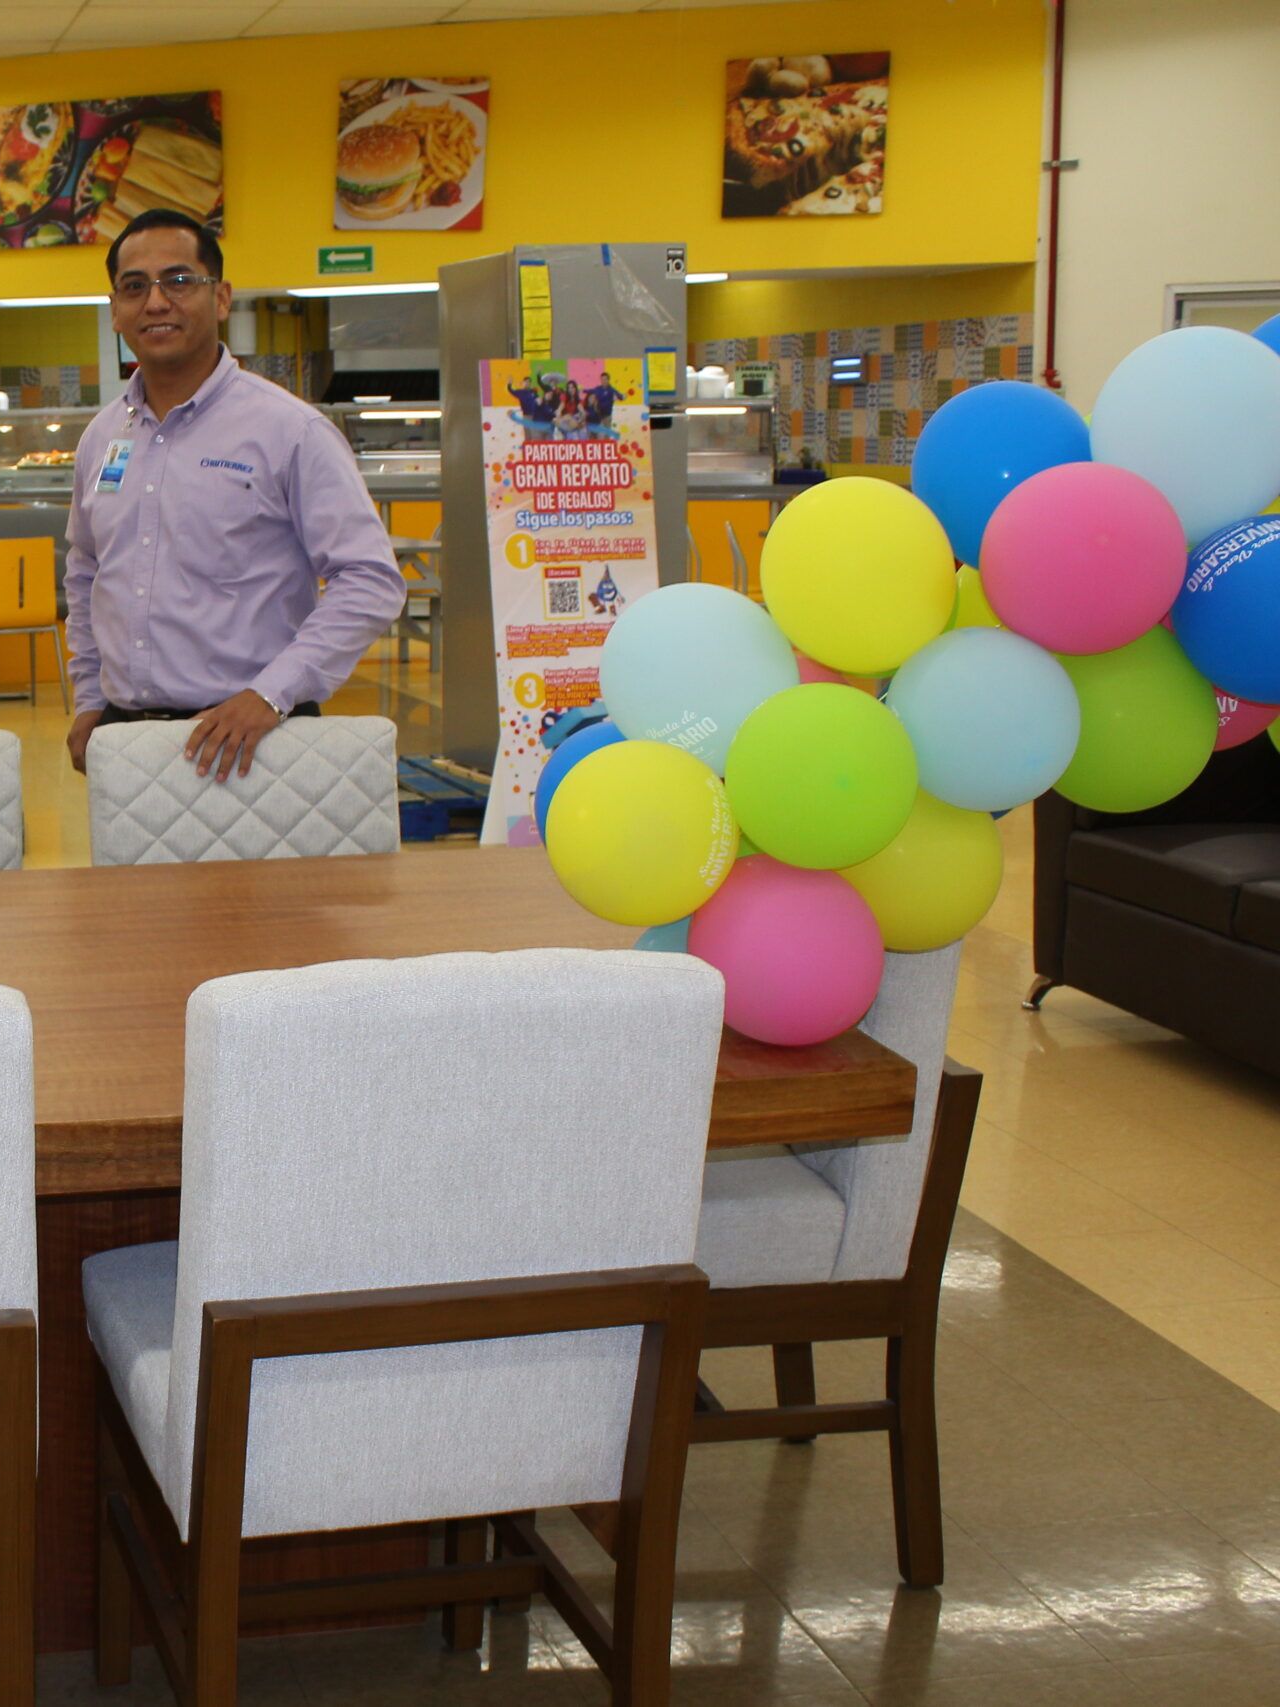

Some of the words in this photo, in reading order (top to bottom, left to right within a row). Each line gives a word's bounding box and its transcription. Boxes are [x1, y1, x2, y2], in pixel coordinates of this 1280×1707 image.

[524, 444, 584, 462] PARTICIPA
[586, 443, 601, 460] EN
[603, 442, 618, 460] EL
[515, 464, 558, 488] GRAN
[561, 462, 630, 487] REPARTO
[536, 492, 556, 510] ¡DE
[557, 490, 612, 509] REGALOS!
[516, 511, 559, 531] Sigue
[560, 510, 584, 526] los
[584, 511, 633, 529] pasos:
[517, 539, 530, 564] 1
[535, 539, 551, 548] Con
[554, 538, 565, 547] tu
[569, 537, 595, 547] ticket
[599, 536, 610, 546] de
[614, 536, 646, 547] compra
[1213, 549, 1253, 577] Venta
[1201, 576, 1215, 592] de
[523, 678, 537, 703] 3
[645, 721, 680, 740] Venta
[680, 709, 698, 726] de
[666, 715, 719, 751] SARIO
